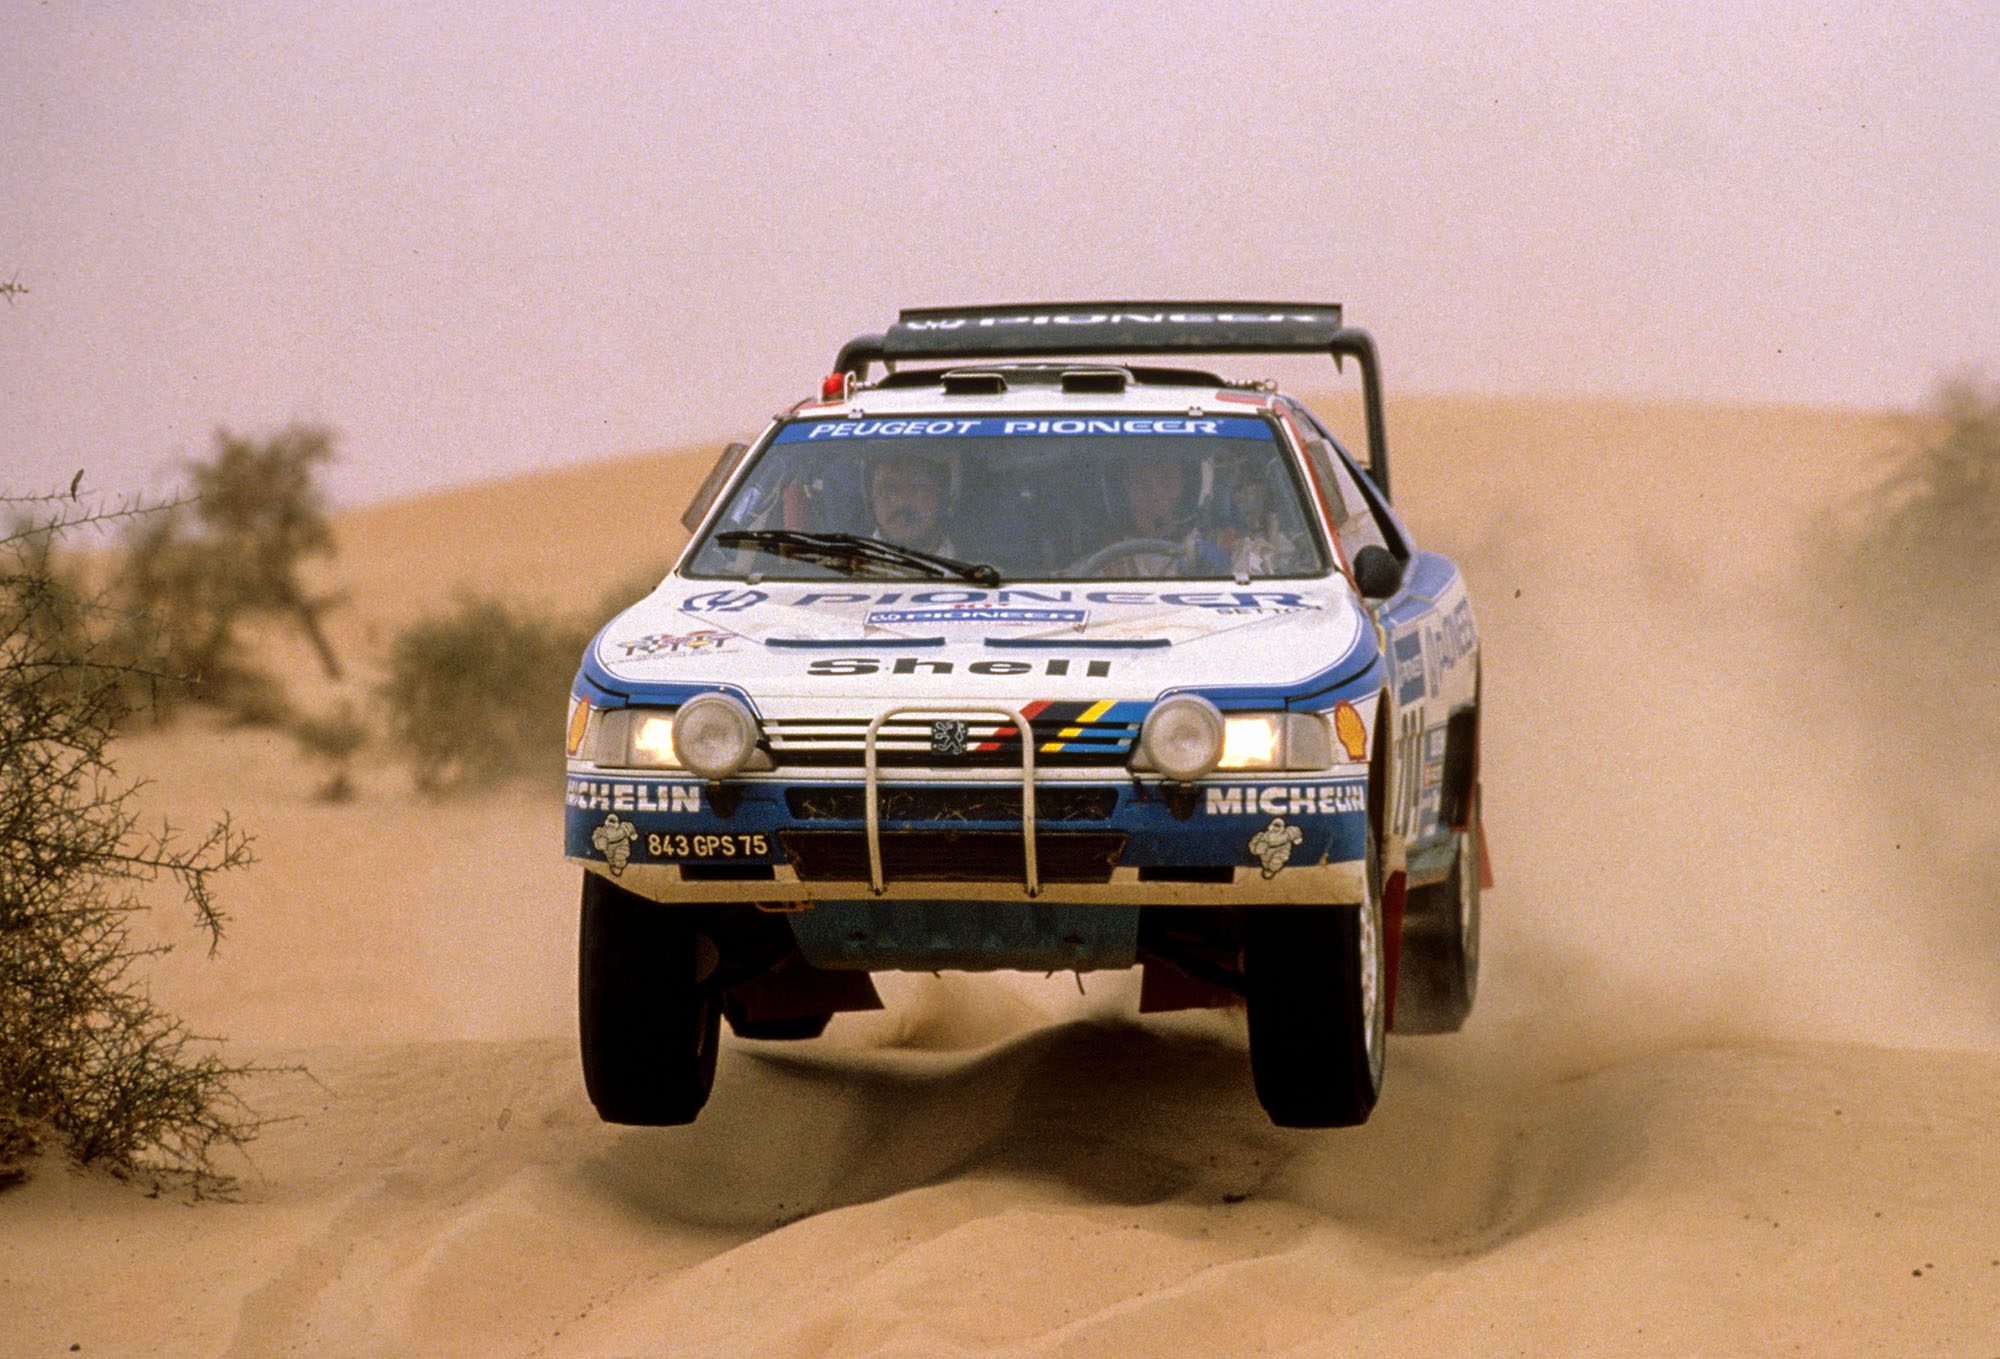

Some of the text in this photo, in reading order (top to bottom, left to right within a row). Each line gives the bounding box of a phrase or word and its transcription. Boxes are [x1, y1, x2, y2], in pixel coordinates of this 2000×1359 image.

[808, 419, 1219, 438] PEUGEOT PIONEER
[790, 590, 1312, 608] PIONEER
[807, 657, 1111, 678] Shell
[1206, 785, 1366, 815] MICHELIN
[648, 834, 768, 857] 843 GPS 75
